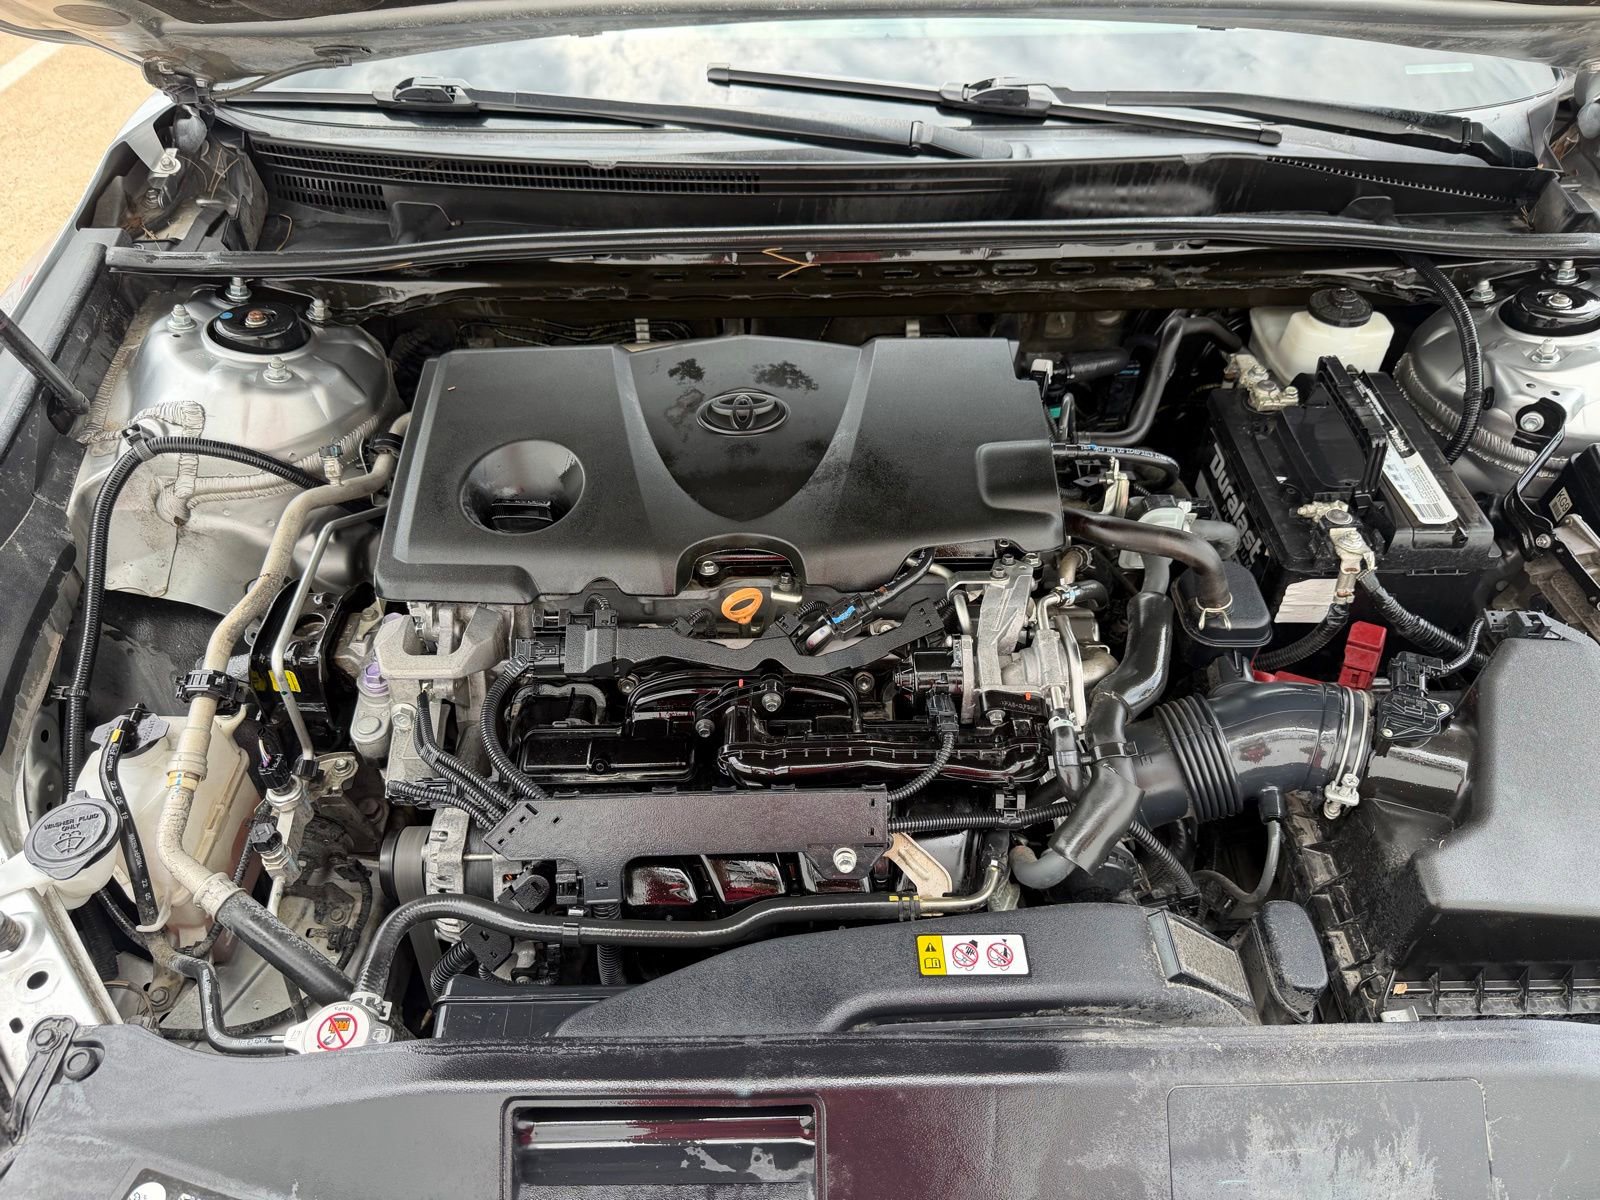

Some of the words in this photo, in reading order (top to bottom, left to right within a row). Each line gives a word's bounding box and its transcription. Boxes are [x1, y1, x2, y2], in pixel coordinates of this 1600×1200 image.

[1209, 442, 1263, 564] Duralast
[1556, 490, 1570, 512] KG9
[115, 796, 124, 806] 05
[121, 811, 129, 820] 19
[44, 818, 75, 831] WASHER
[78, 812, 99, 822] FLUID
[61, 823, 80, 832] ONLY
